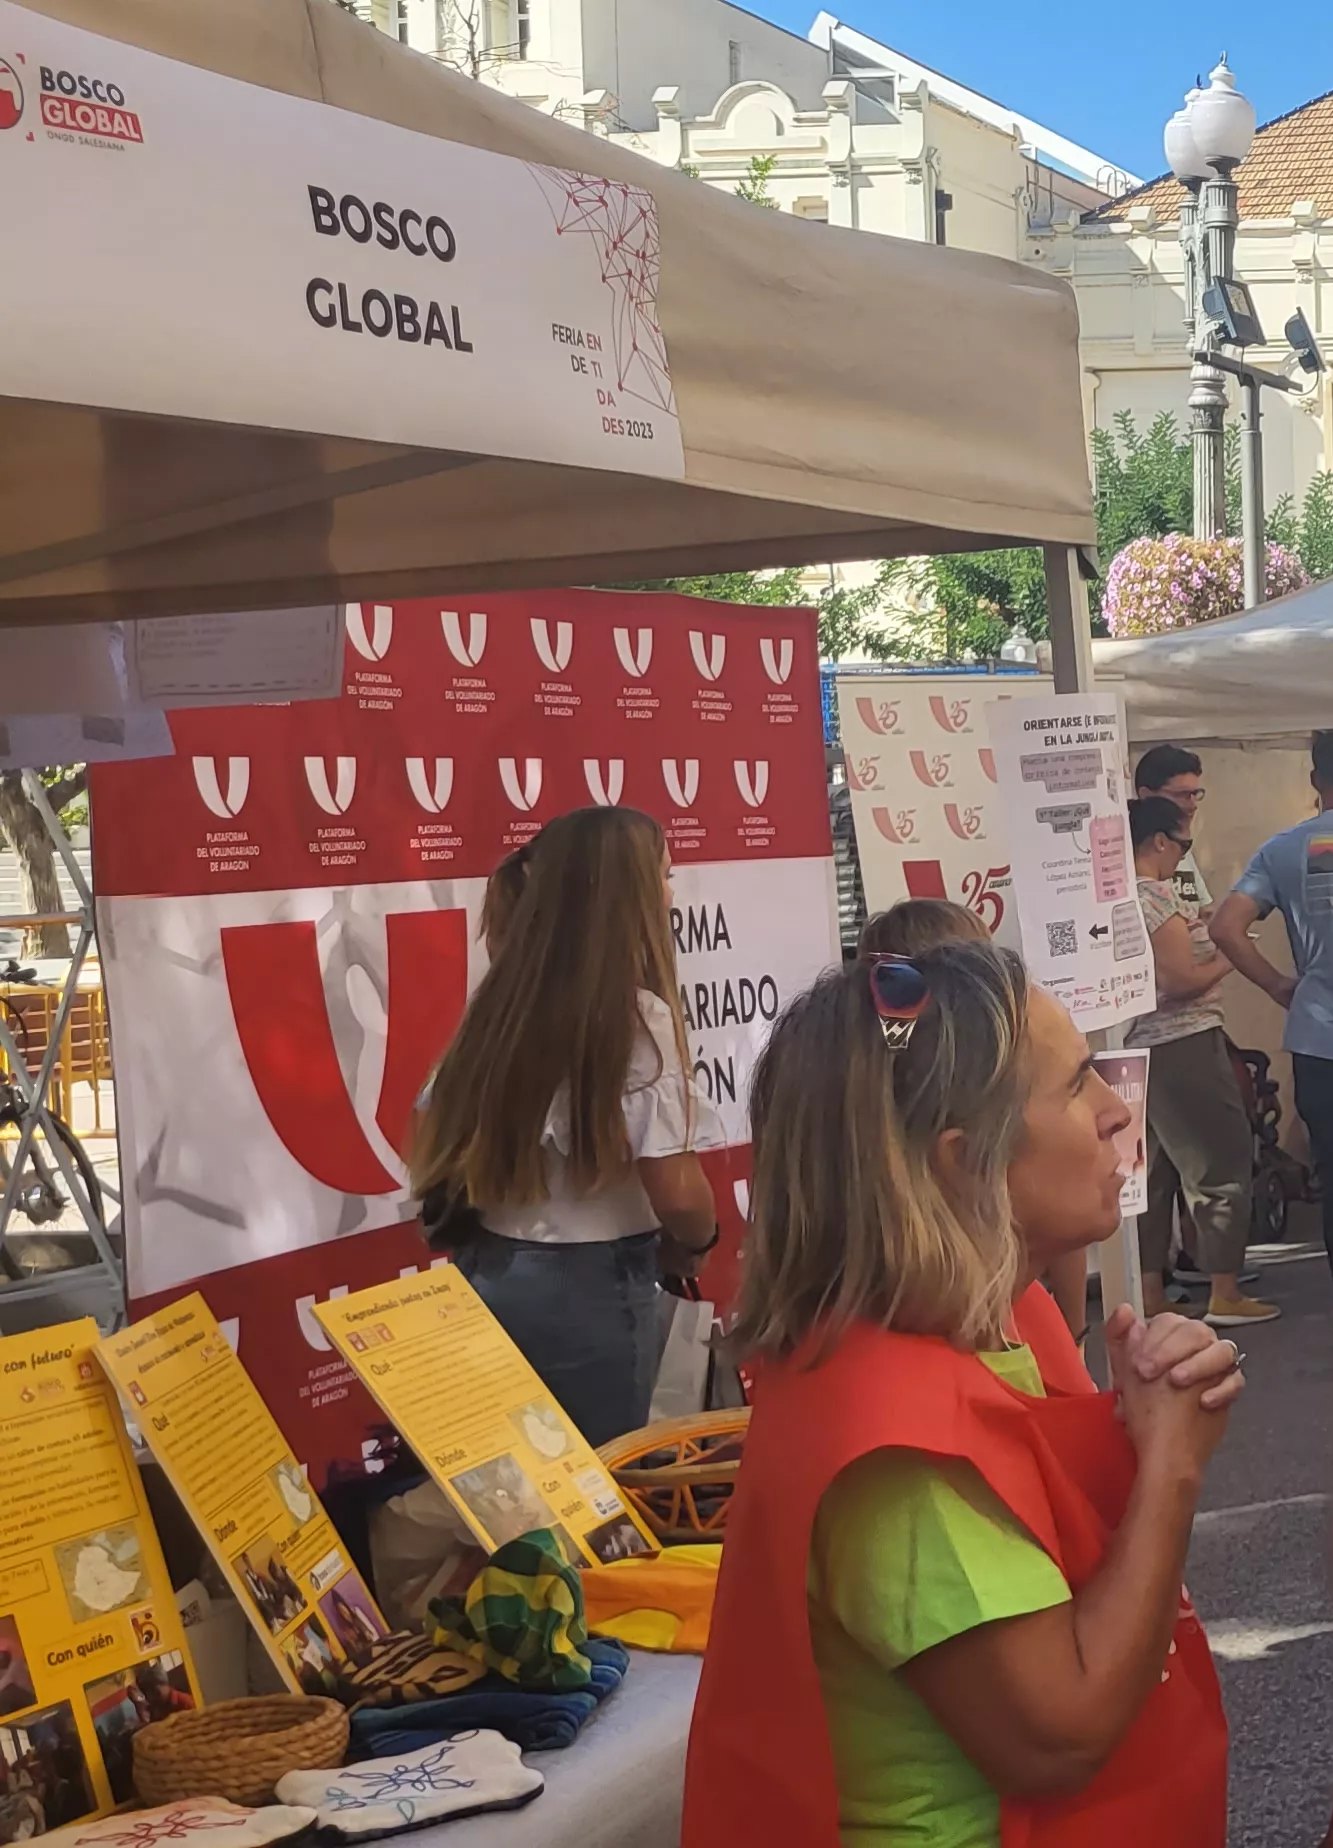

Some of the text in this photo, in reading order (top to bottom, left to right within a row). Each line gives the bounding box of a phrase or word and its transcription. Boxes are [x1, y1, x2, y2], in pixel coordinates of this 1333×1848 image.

[40, 66, 125, 107] BOSCO
[43, 98, 141, 140] GLOBAL
[307, 184, 456, 263] BOSCO
[306, 277, 474, 353] GLOBAL
[551, 323, 603, 352] FERIA EN
[570, 354, 604, 379] DE TI
[597, 388, 617, 408] DA
[602, 416, 654, 440] DES 2023
[1023, 715, 1082, 731] ORIENTARSE
[1044, 733, 1073, 746] EN LA
[670, 903, 732, 954] RMA
[680, 974, 779, 1031] ARIADO
[694, 1044, 737, 1104] ÓN
[4, 1360, 27, 1375] con
[47, 1633, 114, 1666] Con quién
